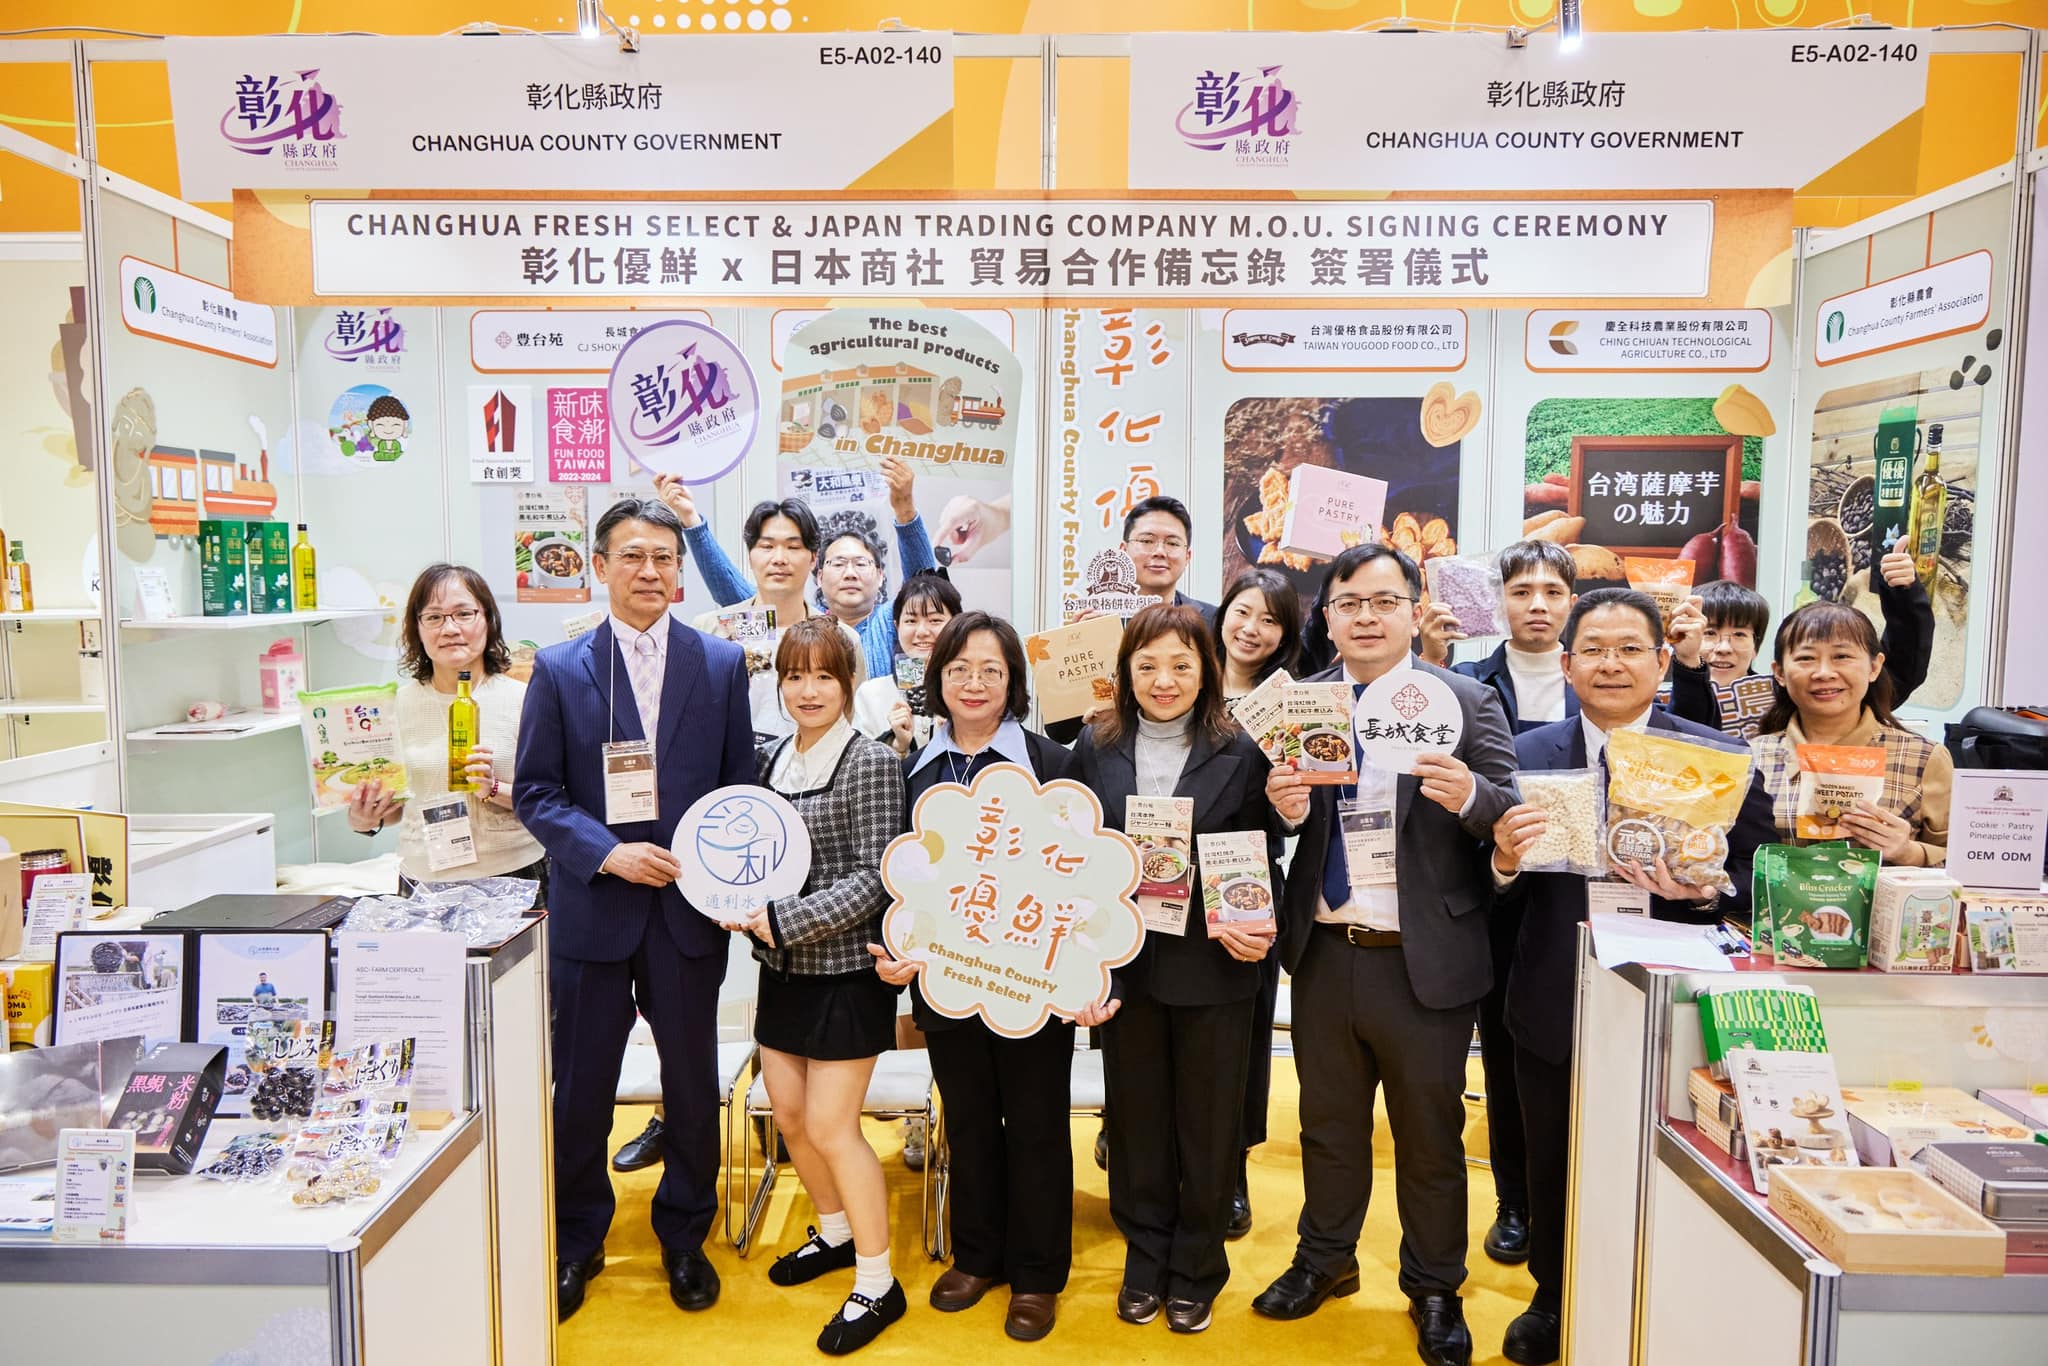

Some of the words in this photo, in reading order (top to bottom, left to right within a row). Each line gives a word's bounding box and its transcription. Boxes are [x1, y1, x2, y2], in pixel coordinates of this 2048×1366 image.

[820, 46, 942, 65] E5-A02-140
[1790, 43, 1918, 63] E5-A02-140
[526, 82, 663, 111] 彰化縣政府
[1194, 70, 1293, 138] 彰化
[1487, 80, 1625, 109] 彰化縣政府
[235, 74, 336, 141] 彰化
[412, 134, 533, 152] CHANGHUA
[540, 134, 627, 151] COUNTY
[633, 133, 782, 150] GOVERNMENT
[1235, 138, 1291, 155] 縣政府
[1366, 131, 1488, 149] CHANGHUA
[1495, 131, 1584, 149] COUNTY
[1590, 130, 1744, 148] GOVERNMENT
[282, 142, 337, 160] 縣政府
[347, 214, 523, 237] CHANGHUA
[534, 214, 634, 237] FRESH
[646, 215, 760, 238] SELECT
[771, 215, 793, 238] &
[804, 215, 901, 238] JAPAN
[915, 214, 1054, 238] TRADING
[1067, 214, 1218, 238] COMPANY
[1230, 215, 1334, 238] M.O.U.
[1347, 215, 1480, 238] SIGNING
[1493, 214, 1668, 237] CEREMONY
[521, 247, 698, 285] 彰化優鮮
[770, 247, 944, 286] 日本商社
[969, 247, 1286, 287] 貿易合作備忘錄
[1310, 247, 1489, 286] 簽署儀式
[1890, 286, 1934, 309] 彰化縣農會
[161, 305, 195, 324] Changhua
[195, 315, 218, 333] County
[1847, 319, 1880, 338] Changhua
[1880, 312, 1904, 330] County
[1937, 290, 1984, 314] Association
[335, 310, 401, 353] 彰化
[605, 326, 647, 338] 長城食
[869, 317, 903, 331] The
[907, 319, 949, 338] best
[1311, 324, 1453, 337] 台灣優格食品股份有限公司
[1605, 320, 1749, 333] 慶全科技農業股份有限公司
[577, 343, 590, 352] CJ
[1303, 341, 1339, 351] TAIWAN
[1341, 341, 1389, 351] YOUGOOD
[1391, 341, 1419, 351] FOOD
[1420, 341, 1440, 352] CO.,
[1442, 340, 1459, 351] LTD
[1599, 337, 1630, 347] CHING
[1672, 337, 1752, 347] TECHNOLOGICAL
[809, 334, 919, 355] agricultural
[923, 342, 1001, 375] products
[1060, 307, 1080, 422] hanghua
[1620, 349, 1686, 359] AGRICULTURE
[1688, 349, 1708, 361] CO.,
[1710, 349, 1727, 359] LTD
[630, 361, 729, 425] 彰化
[553, 391, 604, 418] 新味
[551, 418, 607, 446] 食潮
[687, 406, 736, 437] 縣政府
[553, 449, 574, 459] FUN
[576, 449, 605, 459] FOOD
[835, 436, 858, 453] in
[864, 434, 1006, 466] Changhua
[555, 459, 606, 471] TAIWAN
[1060, 428, 1081, 515] County
[558, 472, 602, 482] 2022-2024
[1588, 471, 1720, 497] 台湾薩摩芋
[1327, 497, 1355, 510] PURE
[1613, 500, 1691, 526] の魅力
[1318, 507, 1361, 522] PASTRY
[1062, 520, 1080, 588] Fresh
[1063, 650, 1095, 666] PURE
[1058, 660, 1106, 680] PASTRY
[1359, 718, 1455, 746] 長城食堂
[1836, 790, 1865, 799] POTATO
[966, 797, 1086, 875] 彰化
[1969, 820, 1999, 830] Cookie
[2008, 822, 2035, 832] Pastry
[1969, 831, 2011, 841] Pineapple
[2012, 833, 2033, 841] Cake
[1967, 850, 1995, 861] OEM
[2001, 851, 2032, 862] ODM
[1799, 882, 1818, 893] Bliss
[1818, 883, 1852, 893] Cracker
[949, 873, 1068, 972] 優鮮
[928, 942, 1001, 974] Changhua
[1005, 966, 1058, 994] County
[943, 966, 984, 989] Fresh
[986, 980, 1033, 1004] Select
[167, 1091, 190, 1110] 粉
